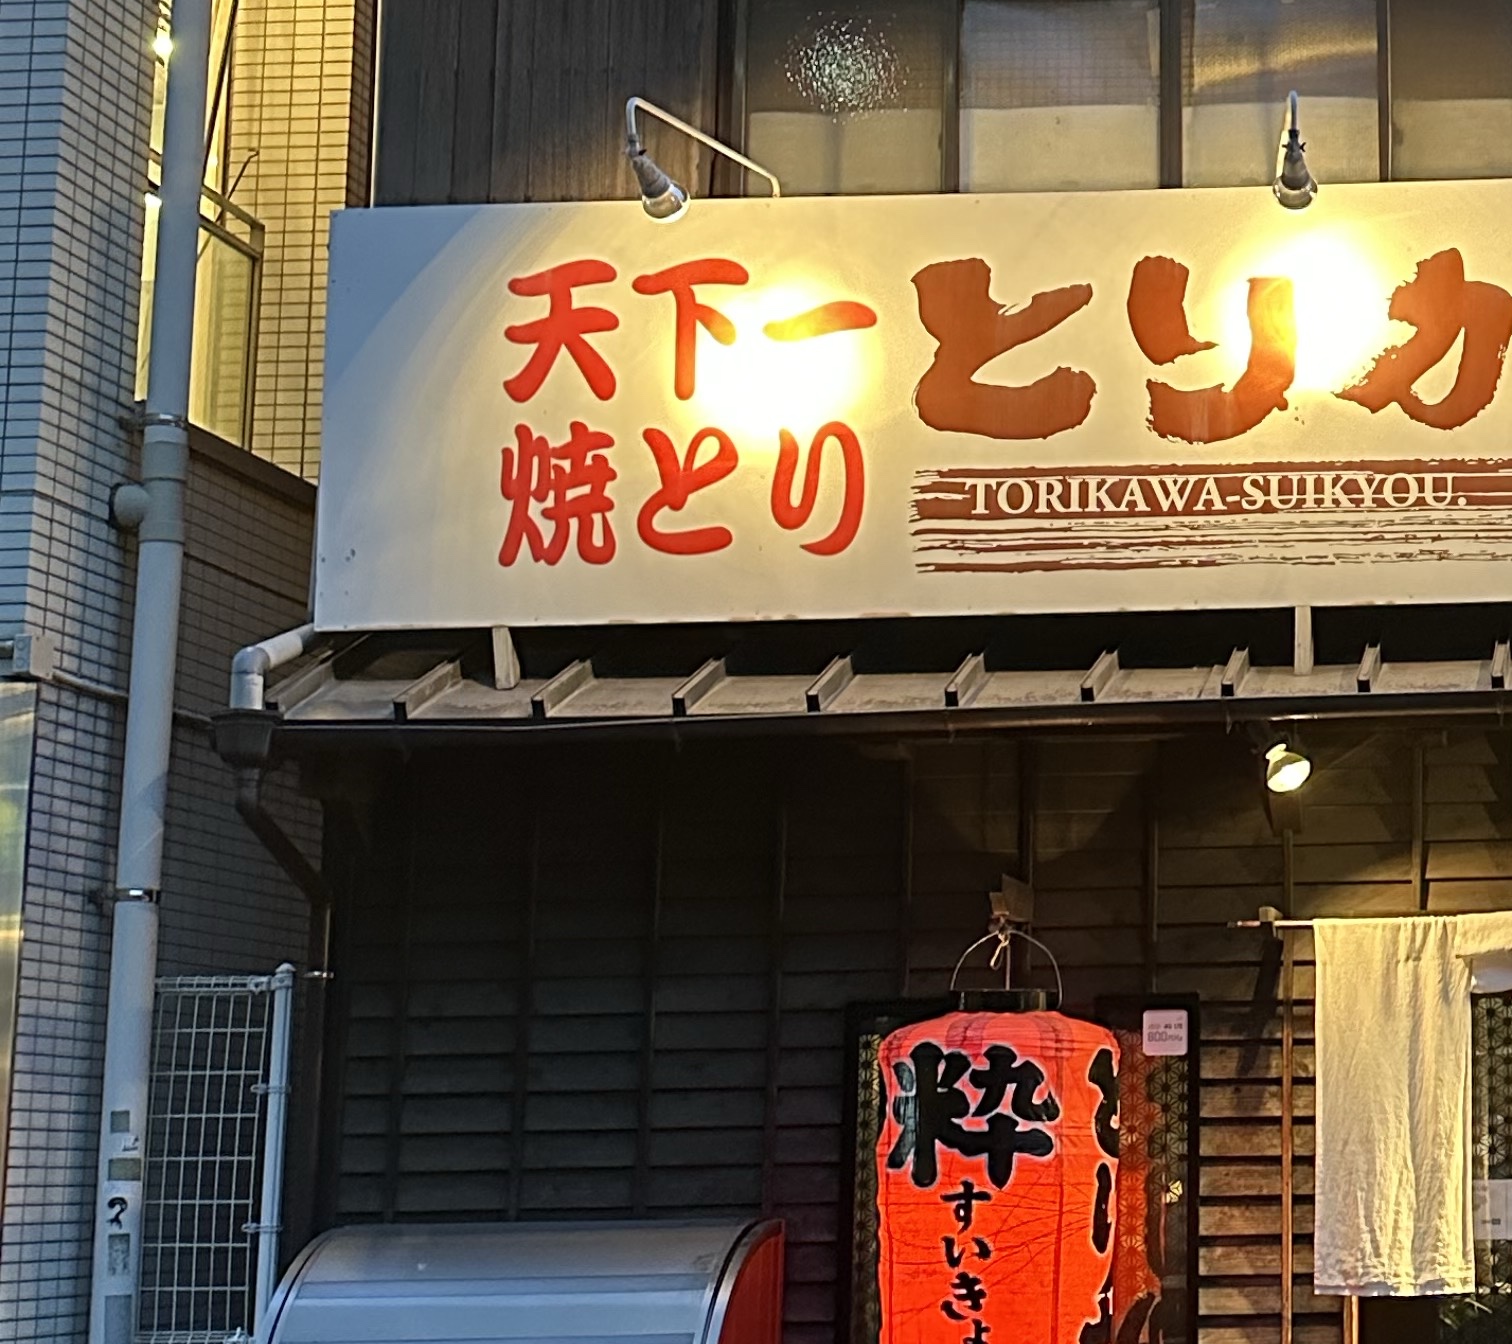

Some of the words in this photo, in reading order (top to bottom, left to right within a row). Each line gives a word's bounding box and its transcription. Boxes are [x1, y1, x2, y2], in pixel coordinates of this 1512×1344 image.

[503, 258, 878, 403] 天下一
[498, 420, 865, 567] 焼とり
[965, 473, 1468, 515] TORIKAWA-SUIKYOU.
